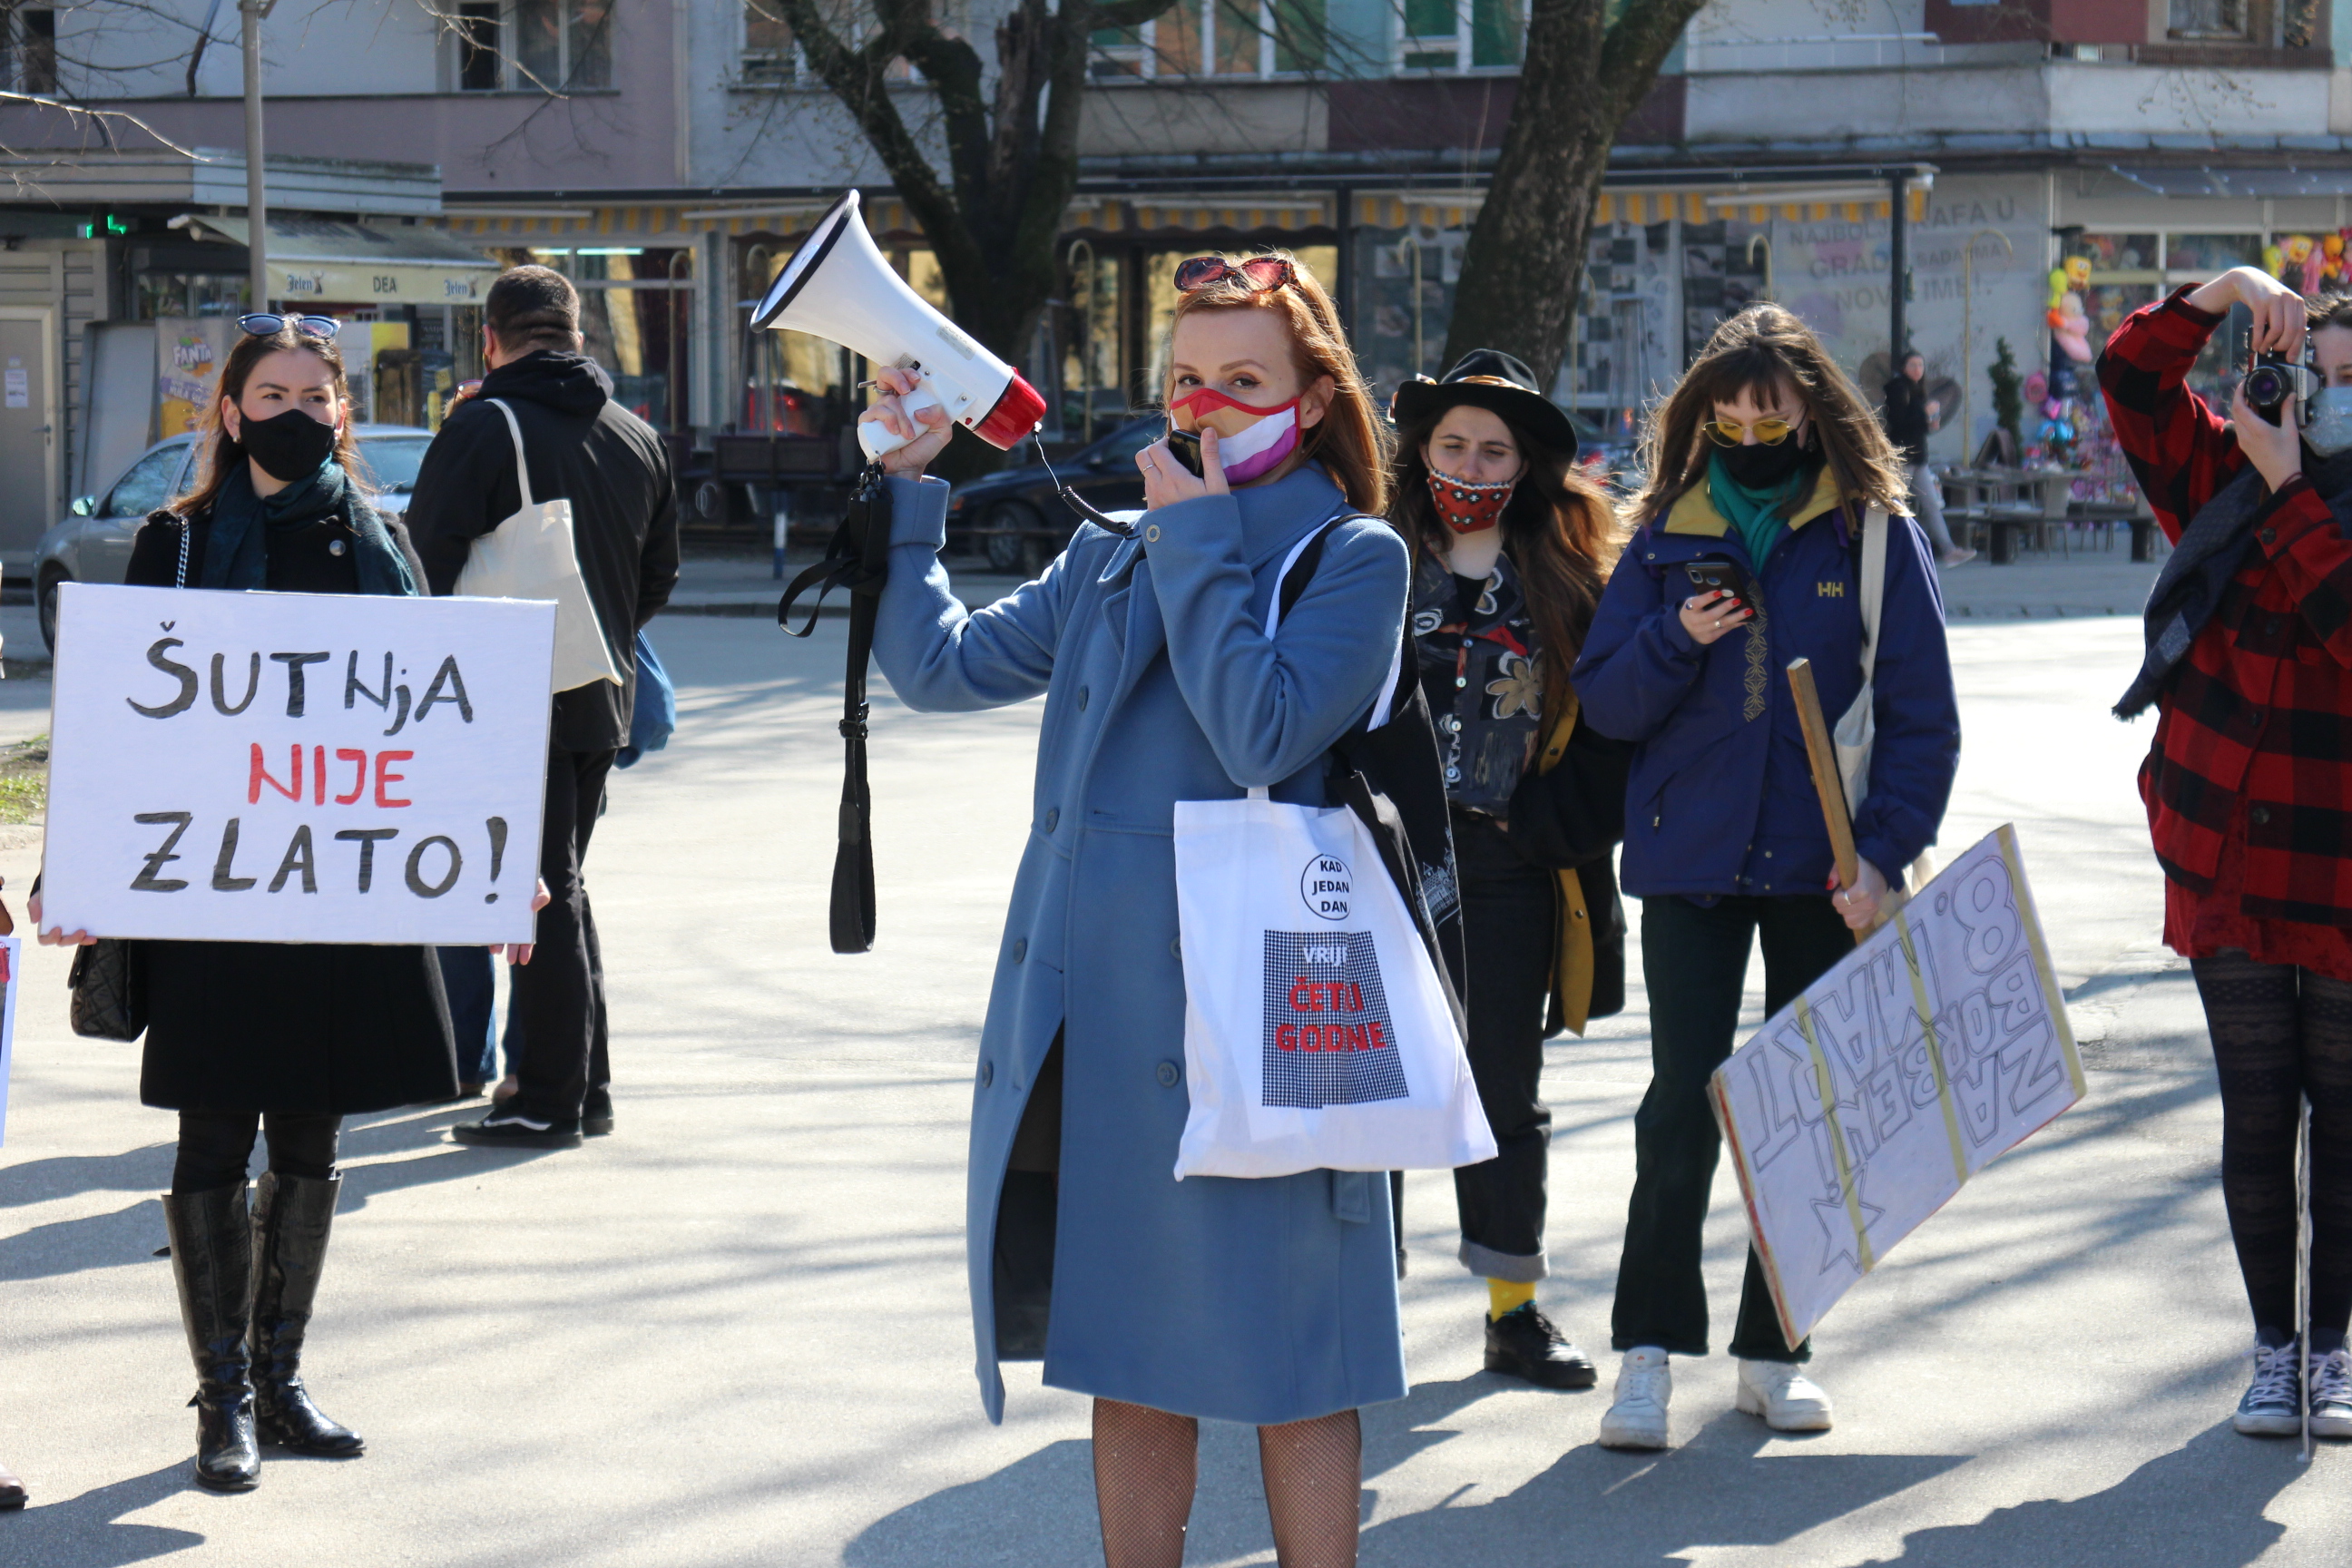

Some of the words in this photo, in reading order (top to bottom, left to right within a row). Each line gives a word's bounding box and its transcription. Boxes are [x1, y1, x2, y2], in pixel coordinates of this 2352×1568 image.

[1789, 219, 1890, 245] NAJBOLJ
[1809, 250, 1890, 280] GRAD
[286, 274, 312, 293] Jelen
[373, 276, 397, 293] DEA
[444, 279, 467, 297] Jelen
[1835, 287, 1890, 313] NOV
[172, 343, 212, 365] FANTA
[1818, 582, 1844, 597] HH
[248, 742, 414, 808] NIJE
[130, 810, 509, 905] ZLATO!
[1320, 860, 1342, 872] KAD
[1312, 880, 1349, 896] JEDAN
[1321, 900, 1348, 913] DAN
[1747, 918, 1943, 1174] MART
[1955, 1013, 2064, 1149] ZA
